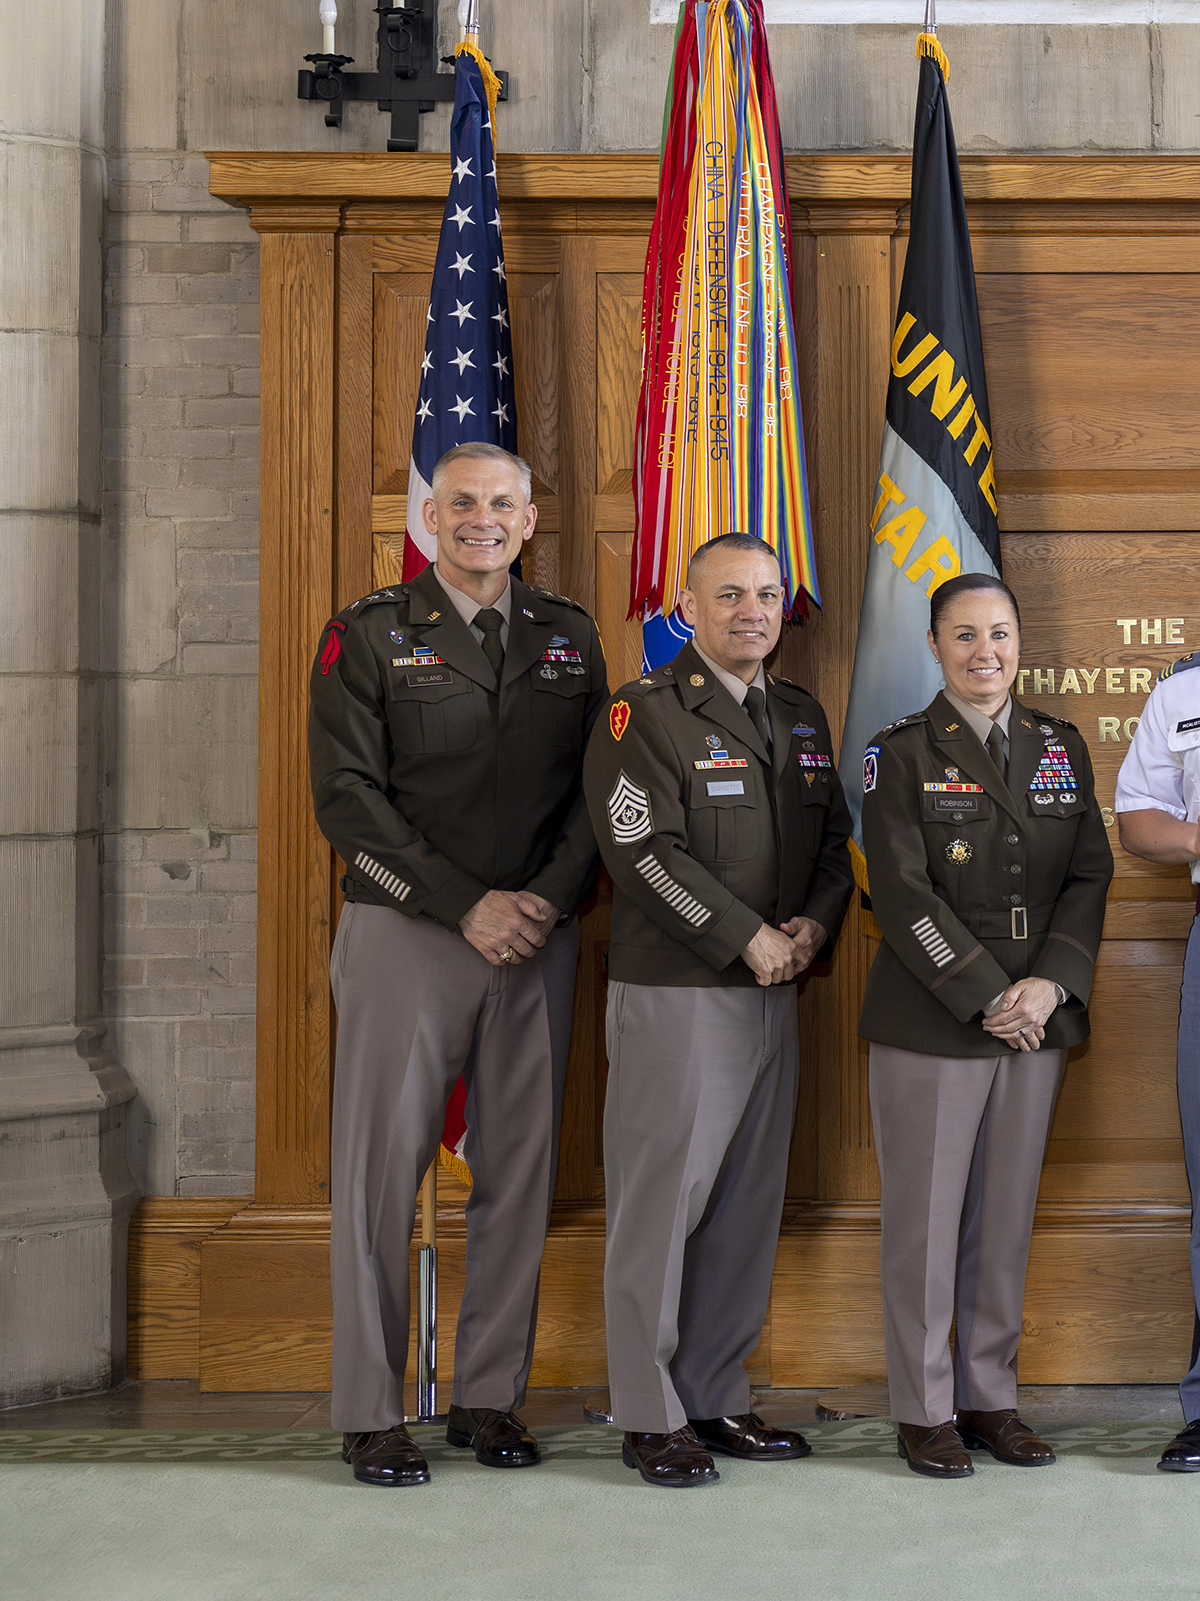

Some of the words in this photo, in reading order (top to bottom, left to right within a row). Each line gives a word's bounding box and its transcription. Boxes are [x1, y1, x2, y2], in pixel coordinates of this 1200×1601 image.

[705, 141, 725, 202] CHINA
[707, 221, 728, 333] DEFENSIVE
[735, 383, 749, 418] 1918
[779, 366, 792, 401] 1918
[764, 402, 776, 437] 1918
[870, 472, 965, 599] TAR
[1116, 618, 1186, 645] THE
[416, 673, 444, 684] GILLAND
[1015, 668, 1152, 696] THAYER
[939, 799, 973, 808] ROBINSON
